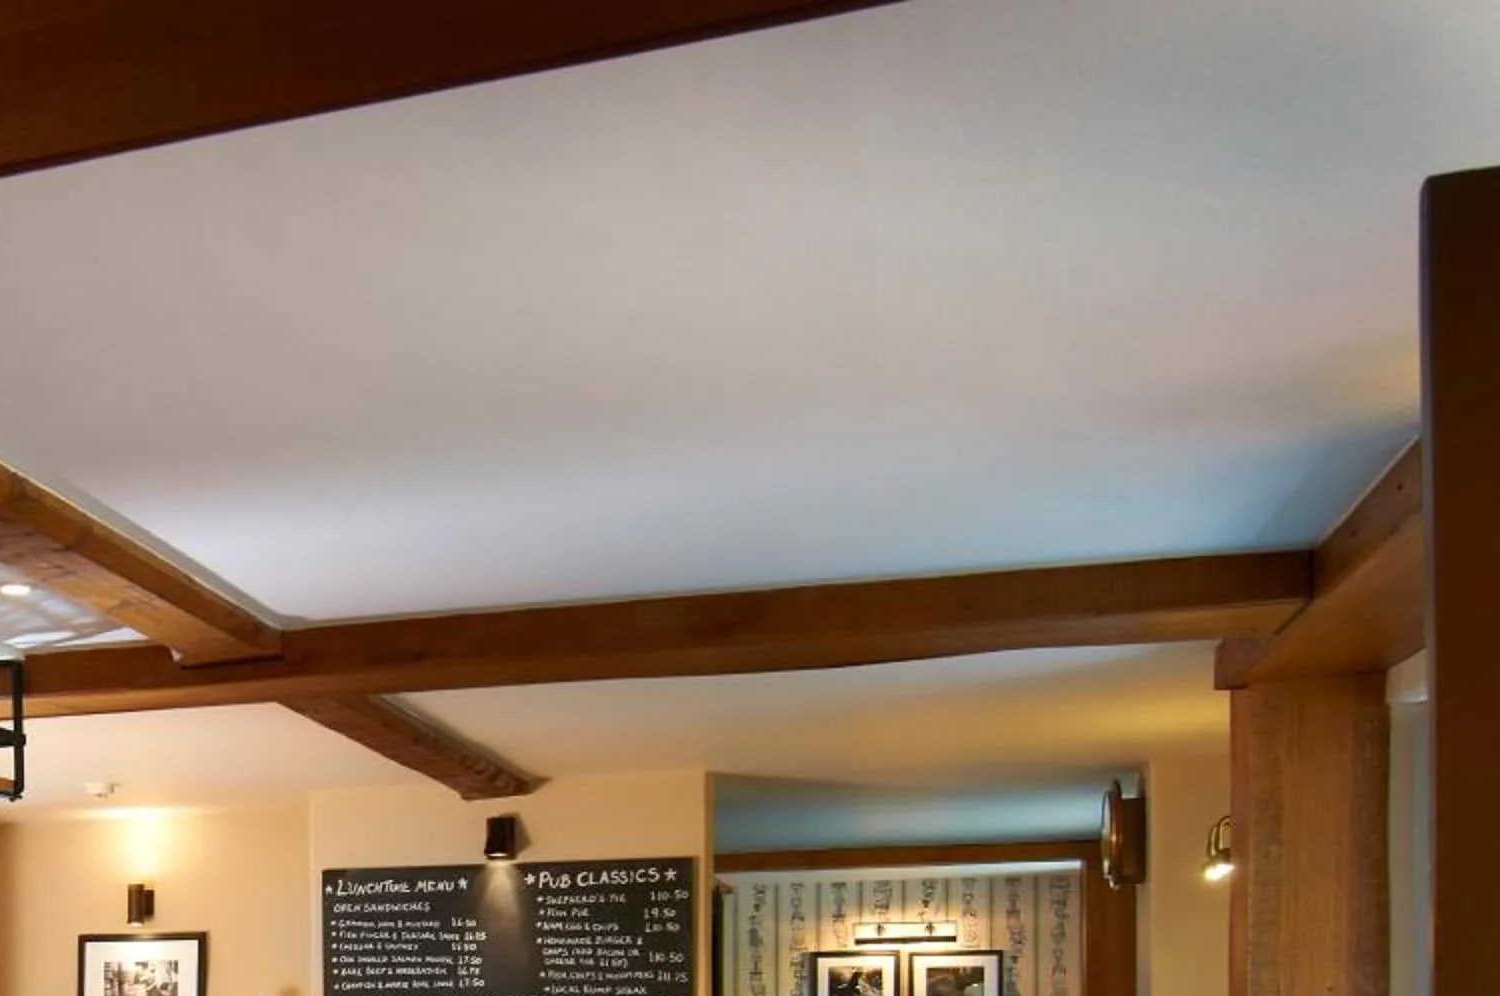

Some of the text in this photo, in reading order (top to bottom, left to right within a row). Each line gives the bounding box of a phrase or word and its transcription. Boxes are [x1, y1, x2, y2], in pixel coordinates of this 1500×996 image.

[538, 867, 661, 888] PUB CLASSICS
[337, 879, 454, 896] LUNCHTIME MENU
[608, 893, 626, 903] PIE
[333, 901, 431, 913] OPEN SANDWICHES
[571, 907, 590, 917] PIE
